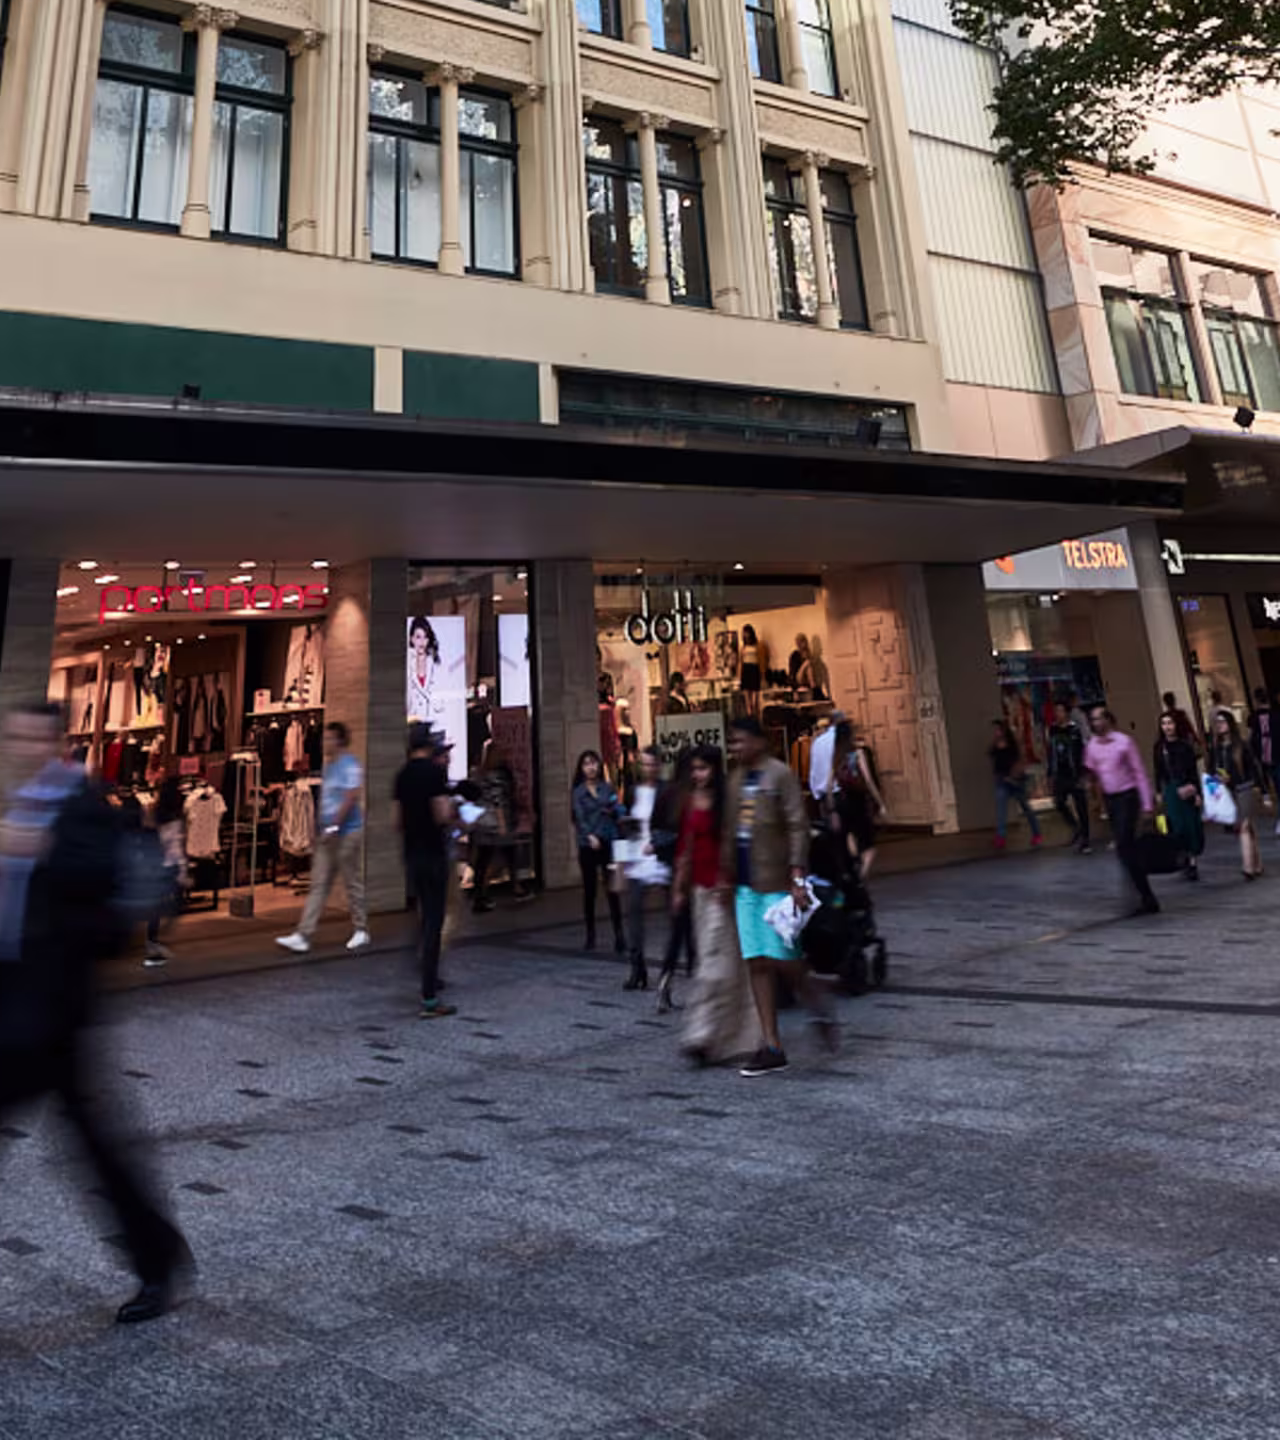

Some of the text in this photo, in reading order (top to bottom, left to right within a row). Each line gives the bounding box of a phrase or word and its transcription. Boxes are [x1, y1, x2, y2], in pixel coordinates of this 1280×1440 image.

[1061, 539, 1129, 570] TELSTRA
[99, 576, 329, 625] portmans
[623, 588, 709, 646] dotti
[694, 728, 721, 746] OFF
